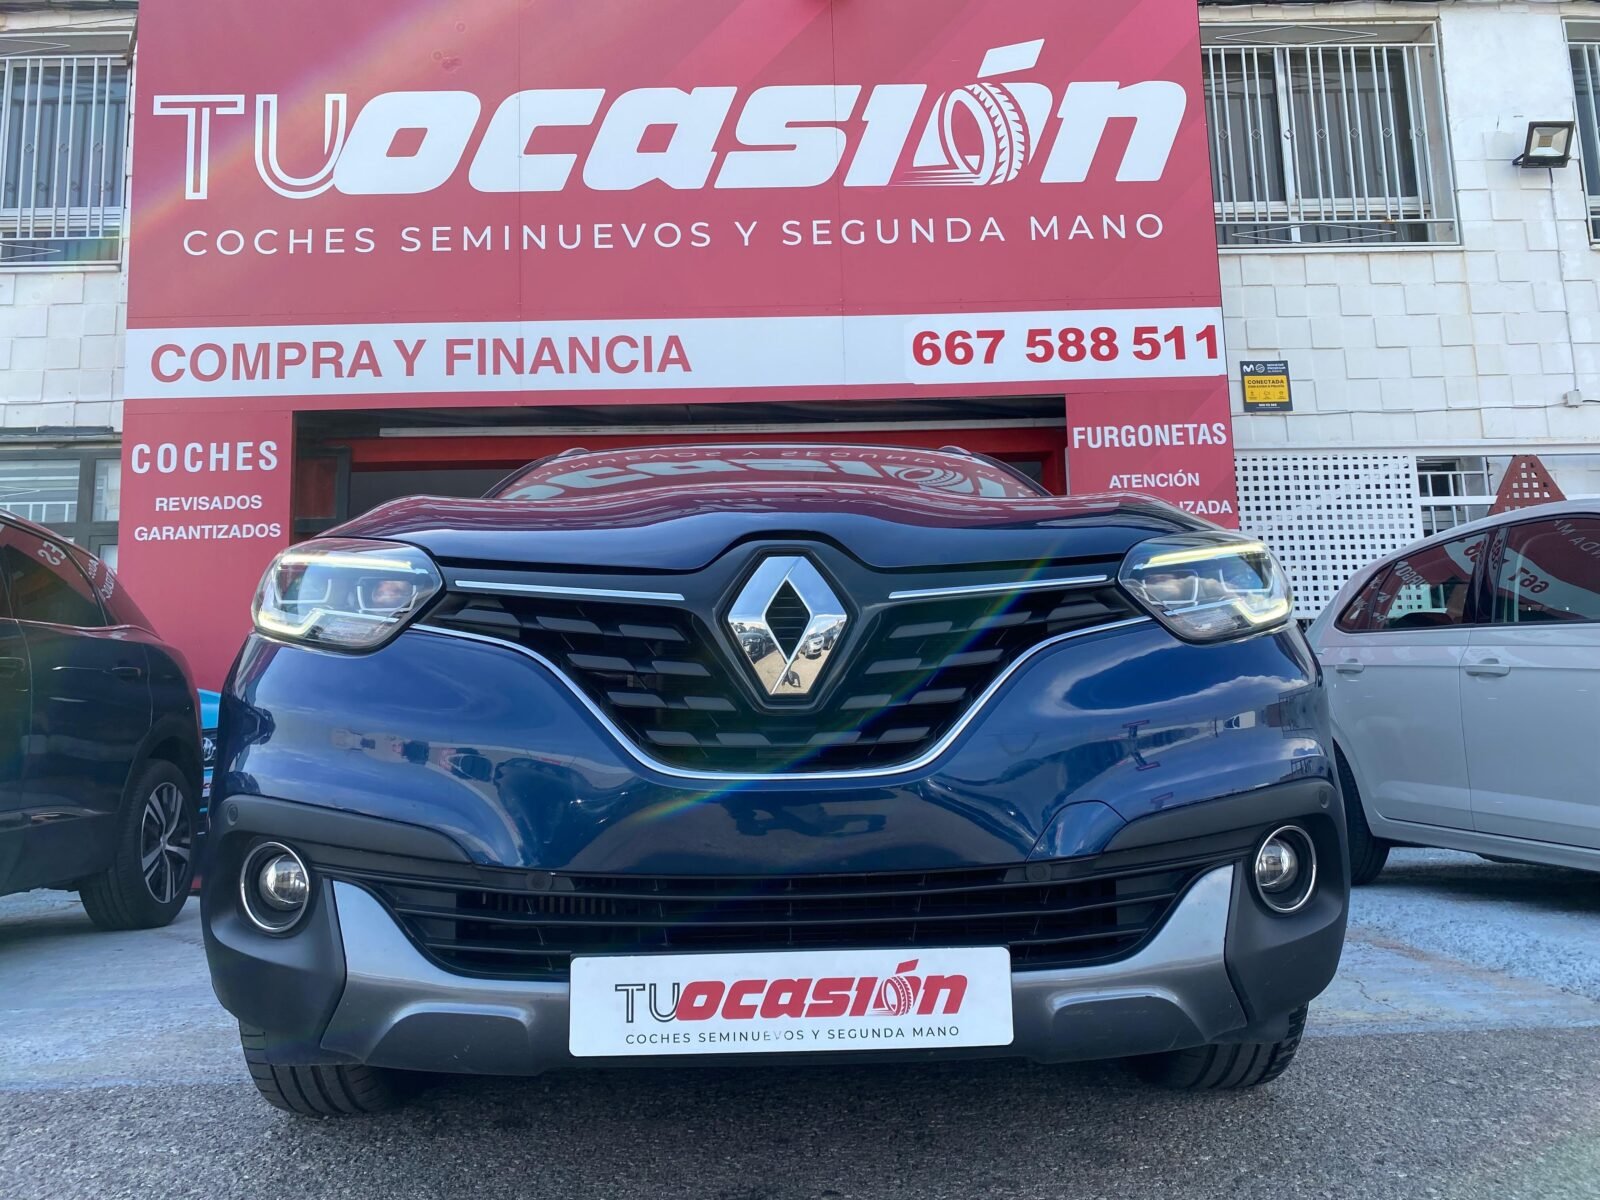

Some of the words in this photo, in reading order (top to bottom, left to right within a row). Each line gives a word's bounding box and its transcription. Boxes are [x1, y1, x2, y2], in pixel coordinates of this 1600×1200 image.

[183, 227, 376, 256] COCHES
[400, 221, 711, 253] SEMINUEVOS
[735, 221, 758, 246] Y
[782, 216, 1005, 246] SEGUNDA
[1030, 213, 1164, 241] MANO
[150, 340, 383, 383] COMPRA
[393, 339, 426, 377] Y
[445, 334, 692, 376] FINANCIA
[912, 329, 1005, 366] 667
[1025, 326, 1119, 364] 588
[1132, 324, 1218, 361] 511
[1073, 422, 1227, 449] FURGONETAS
[131, 440, 278, 474] COCHES
[1109, 469, 1200, 489] ATENCIÓN
[155, 494, 263, 512] REVISADOS
[134, 523, 281, 541] GARANTIZADOS
[625, 1032, 691, 1044] COCHES
[698, 1029, 804, 1044] SEMINUEVOS
[811, 1029, 821, 1040] Y
[827, 1027, 905, 1040] SEGUNDA
[912, 1025, 960, 1037] MANO
